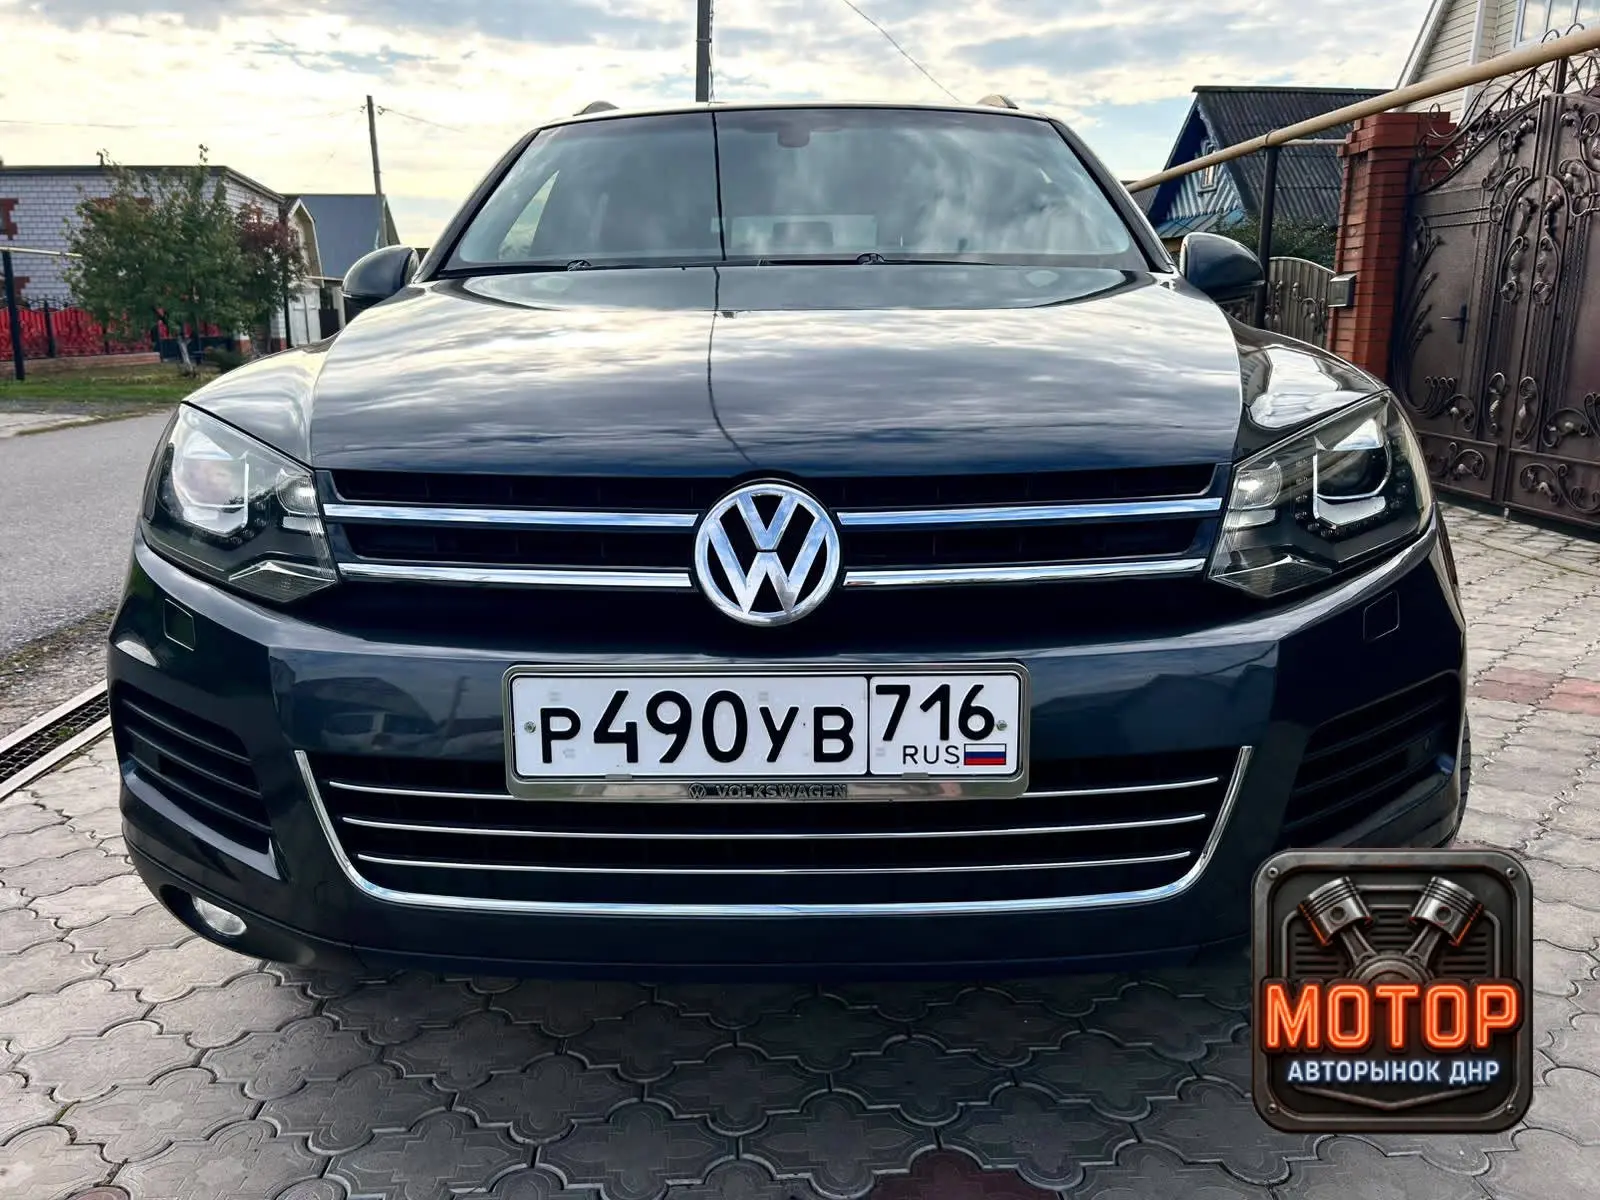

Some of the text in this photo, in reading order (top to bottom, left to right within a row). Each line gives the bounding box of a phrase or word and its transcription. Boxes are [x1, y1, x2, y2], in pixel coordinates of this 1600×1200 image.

[875, 684, 995, 742] 716
[902, 745, 960, 765] RUS
[716, 784, 848, 798] VOLKSWAGEN
